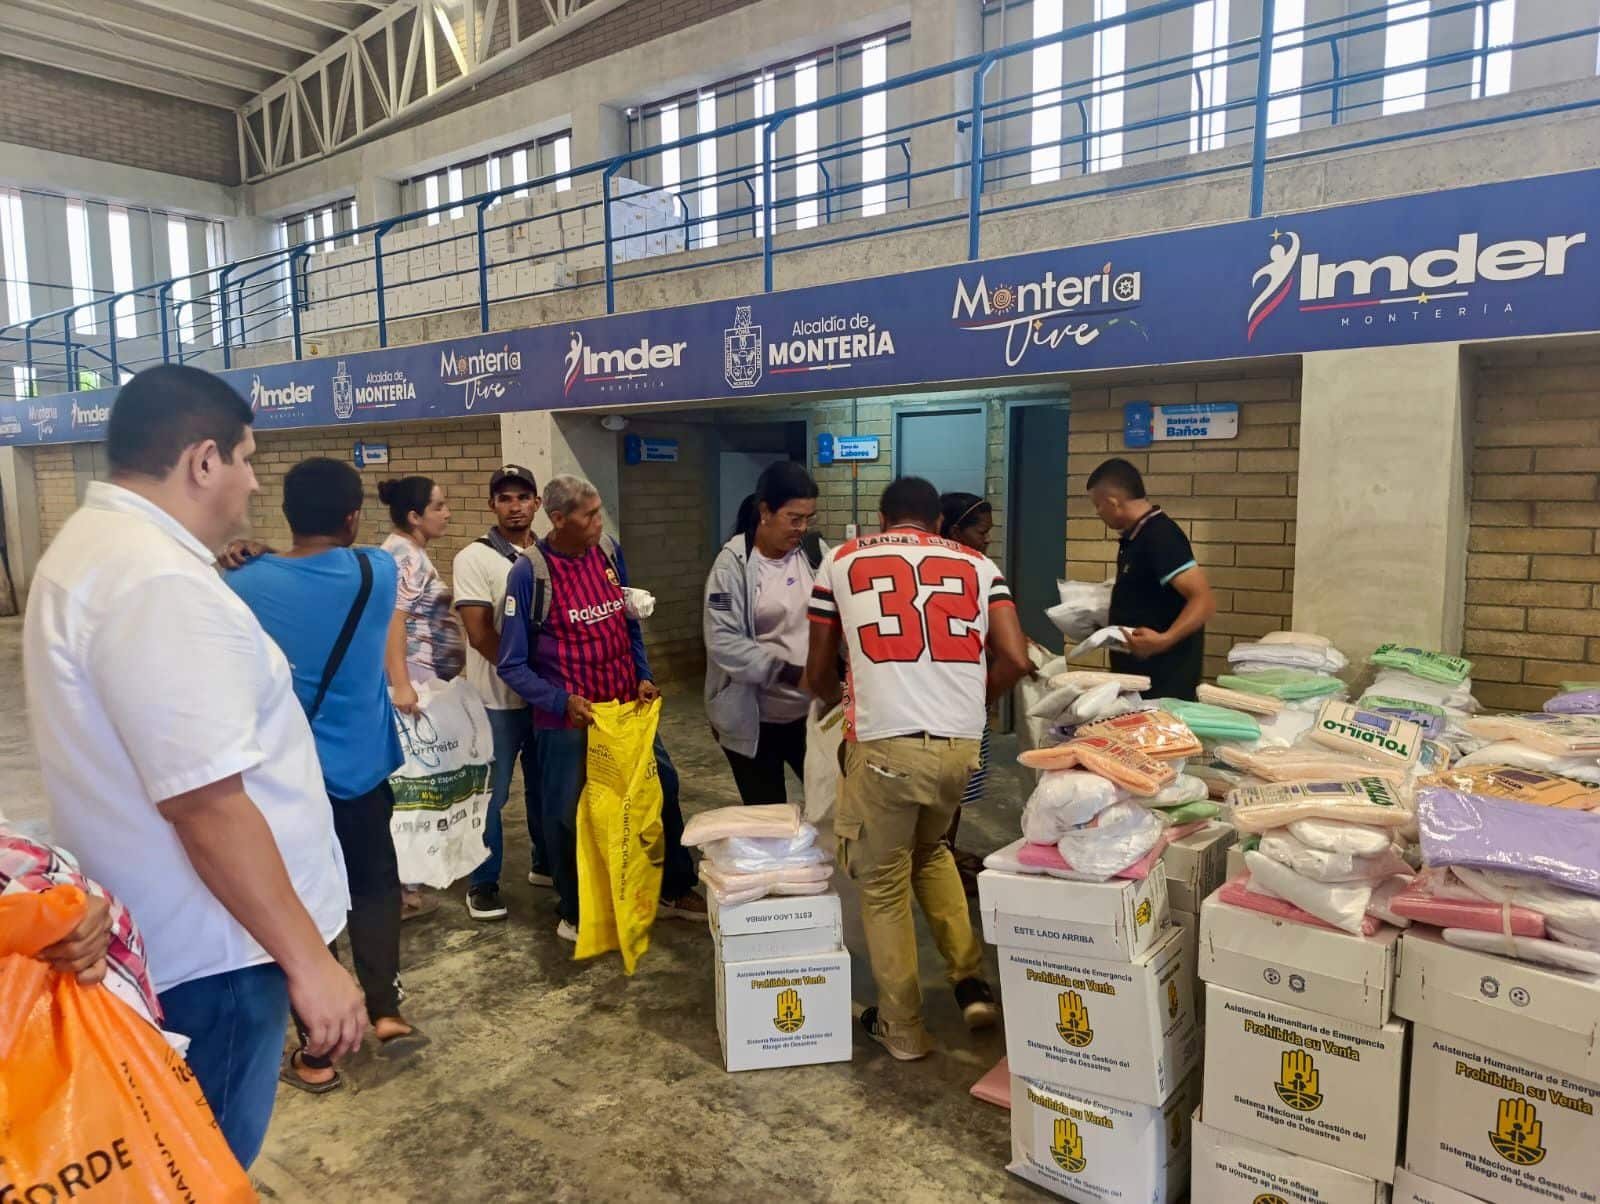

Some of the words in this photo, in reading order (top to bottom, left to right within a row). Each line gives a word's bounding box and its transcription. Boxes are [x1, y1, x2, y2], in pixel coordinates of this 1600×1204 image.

[1299, 231, 1586, 301] Imder
[791, 316, 847, 337] Alcaldía
[849, 313, 869, 329] de
[583, 339, 687, 375] Imder
[768, 324, 895, 366] MONTERÍA
[260, 382, 314, 406] Imder
[355, 379, 416, 404] MONTERÍA
[1167, 426, 1208, 437] Baños
[848, 555, 983, 664] 32
[1323, 719, 1408, 757] TOLDILLO
[746, 914, 772, 923] ARRIBA
[773, 912, 793, 920] LADO
[794, 911, 812, 919] ESTE
[1014, 926, 1035, 937] ESTE
[1037, 928, 1060, 940] LADO
[1061, 931, 1095, 944] ARRIBA
[1224, 1002, 1266, 1019] Asistencia
[1267, 1012, 1318, 1033] Humanitaria
[1320, 1027, 1330, 1036] de
[1332, 1030, 1385, 1050] Emergencia
[1244, 1019, 1303, 1047] Prohibida
[1304, 1038, 1322, 1051] su
[1321, 1039, 1360, 1062] Venta
[1432, 1041, 1482, 1063] Asistencia
[1484, 1056, 1543, 1081] Humanitaria
[1545, 1075, 1558, 1085] de
[1455, 1060, 1525, 1095] Prohibida
[1526, 1085, 1547, 1101] su
[1548, 1088, 1593, 1116] Venta
[1234, 1095, 1266, 1110] Sistema
[1267, 1104, 1303, 1121] Nacional
[1305, 1117, 1316, 1126] de
[1317, 1120, 1351, 1137] Gestión
[1352, 1130, 1367, 1141] del
[1256, 1110, 1285, 1125] Riesgo
[1286, 1120, 1297, 1129] de
[1299, 1123, 1341, 1142] Desastres
[1439, 1142, 1477, 1162] Sistema
[1478, 1155, 1521, 1176] Nacional
[1523, 1171, 1535, 1182] de
[1538, 1176, 1577, 1196] Gestión
[1579, 1191, 1597, 1202] del
[1465, 1160, 1498, 1179] Riesgo
[1500, 1173, 1513, 1184] de
[1515, 1178, 1565, 1202] Desastres
